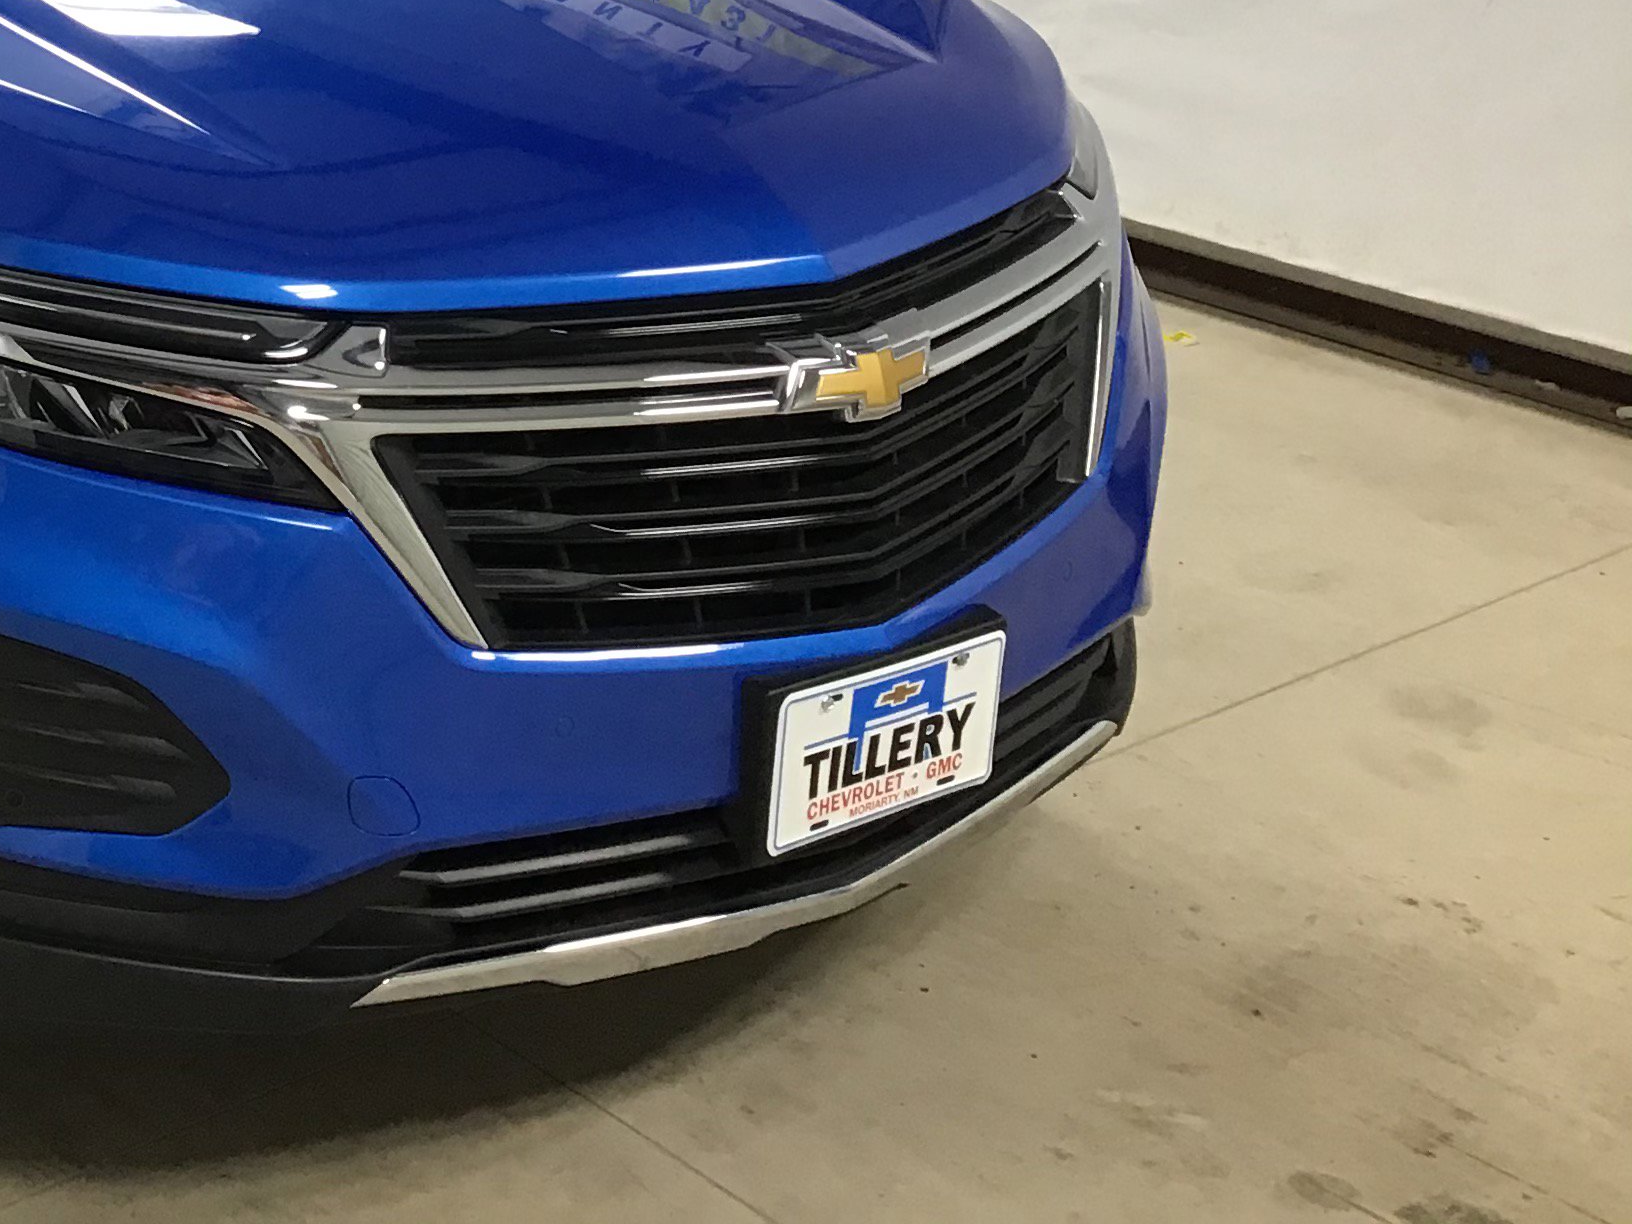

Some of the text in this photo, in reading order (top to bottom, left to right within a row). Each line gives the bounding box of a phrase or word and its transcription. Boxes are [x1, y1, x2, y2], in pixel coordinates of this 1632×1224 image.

[803, 701, 976, 801] TILLERY
[807, 753, 963, 820] CHEVROLET GMC
[904, 786, 920, 801] NM
